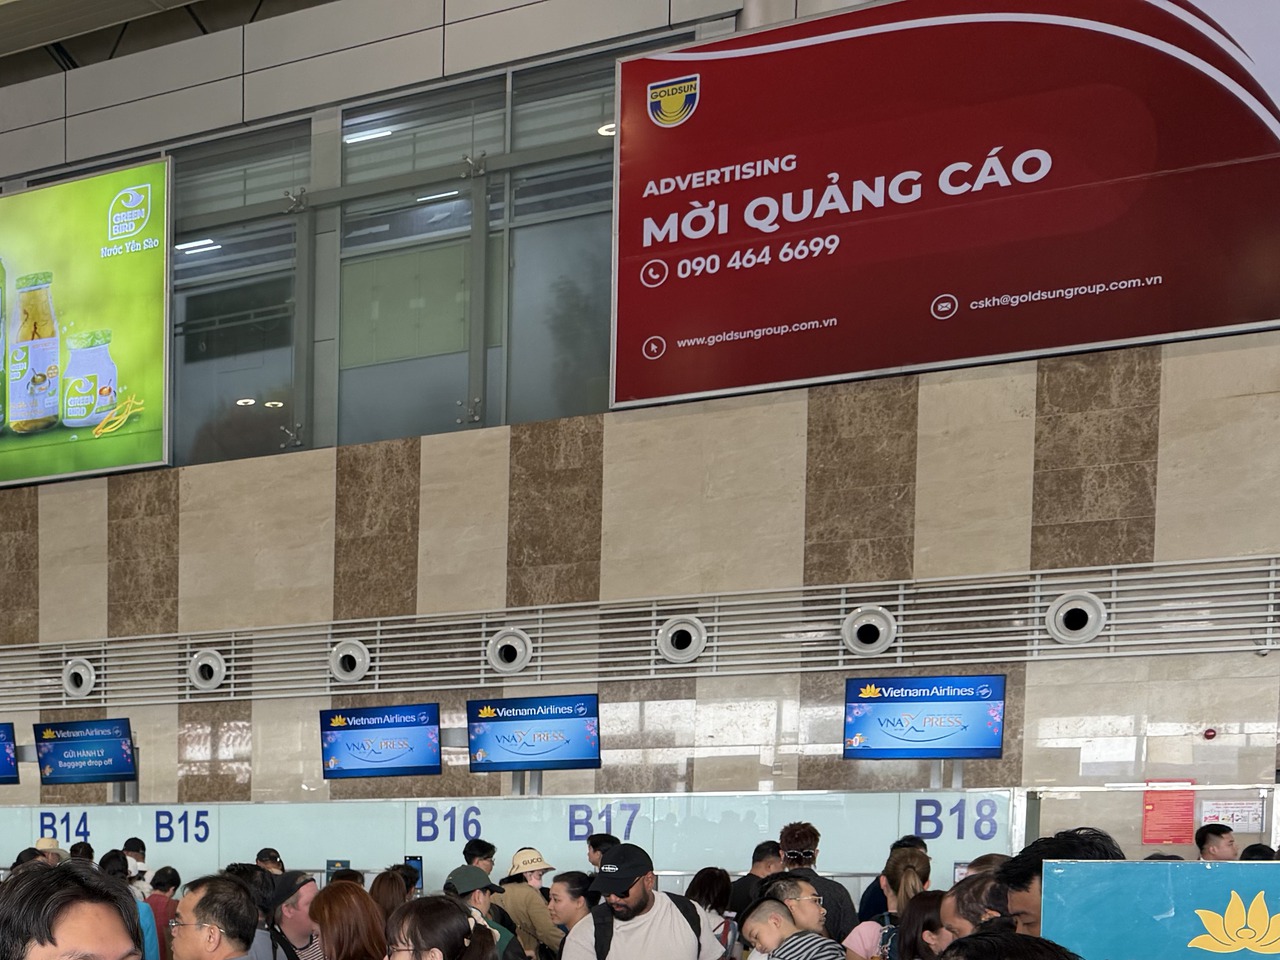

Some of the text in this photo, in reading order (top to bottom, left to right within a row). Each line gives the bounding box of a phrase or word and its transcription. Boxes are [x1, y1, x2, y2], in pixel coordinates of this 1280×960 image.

[650, 82, 698, 101] GOLDSUN
[643, 154, 797, 198] ADVERTISING
[642, 146, 1052, 247] MỜI QUẢNG CÁO
[113, 208, 145, 235] GREEN BIRD
[677, 236, 840, 279] 090 464 6699
[969, 274, 1163, 310] cskh@goldsungroup.com.vn
[677, 317, 838, 348] www.goldsungroup.com.vn
[39, 811, 90, 843] B14
[155, 810, 210, 843] B15
[415, 806, 481, 842] B16
[569, 803, 641, 842] B17
[914, 799, 998, 841] B18
